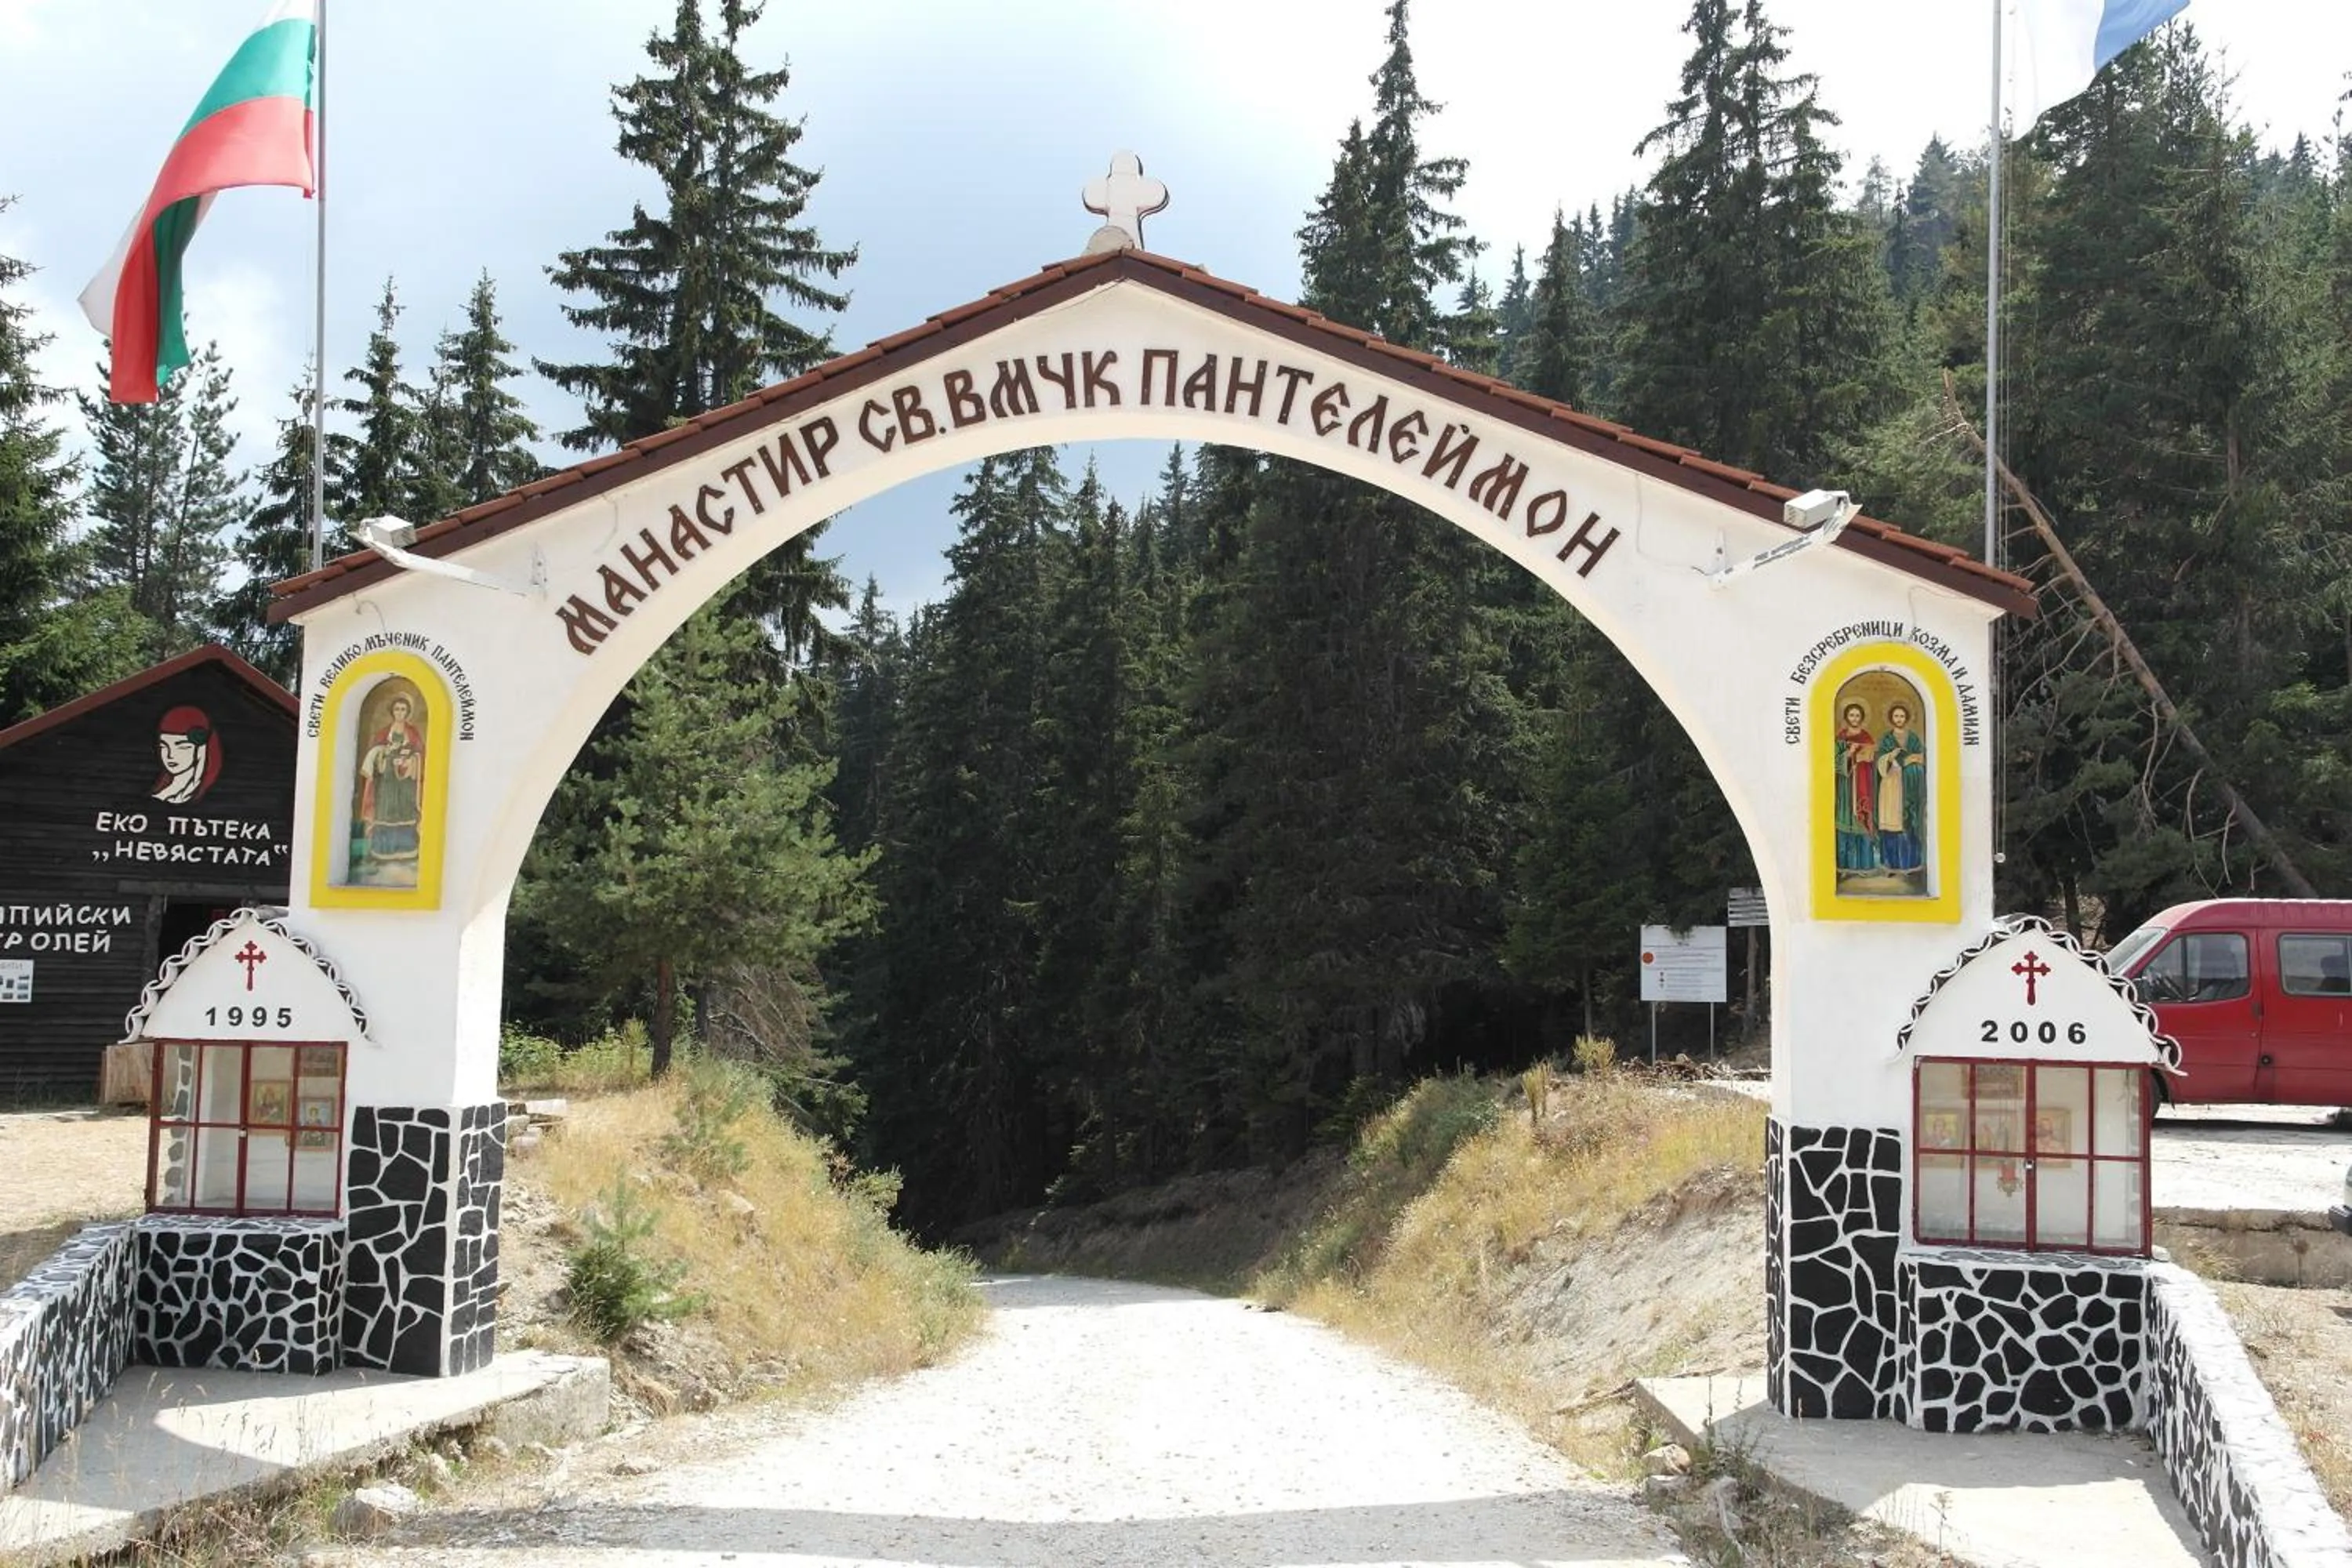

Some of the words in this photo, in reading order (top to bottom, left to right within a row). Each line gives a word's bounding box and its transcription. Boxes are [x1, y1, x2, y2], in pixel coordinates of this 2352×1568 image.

[555, 416, 839, 655] МАНАСТИР
[1141, 349, 1620, 578] ПАНТЕЛЕЙМОН
[1785, 697, 1801, 745] СВЕТИ
[96, 812, 147, 833] ЕКО
[168, 816, 270, 840] ПЪТЕКА
[0, 904, 131, 926] ПИЙСКИ
[0, 930, 111, 953] РОЛЕЙ
[205, 1007, 292, 1028] 1995
[1981, 1020, 2086, 1044] 2006
